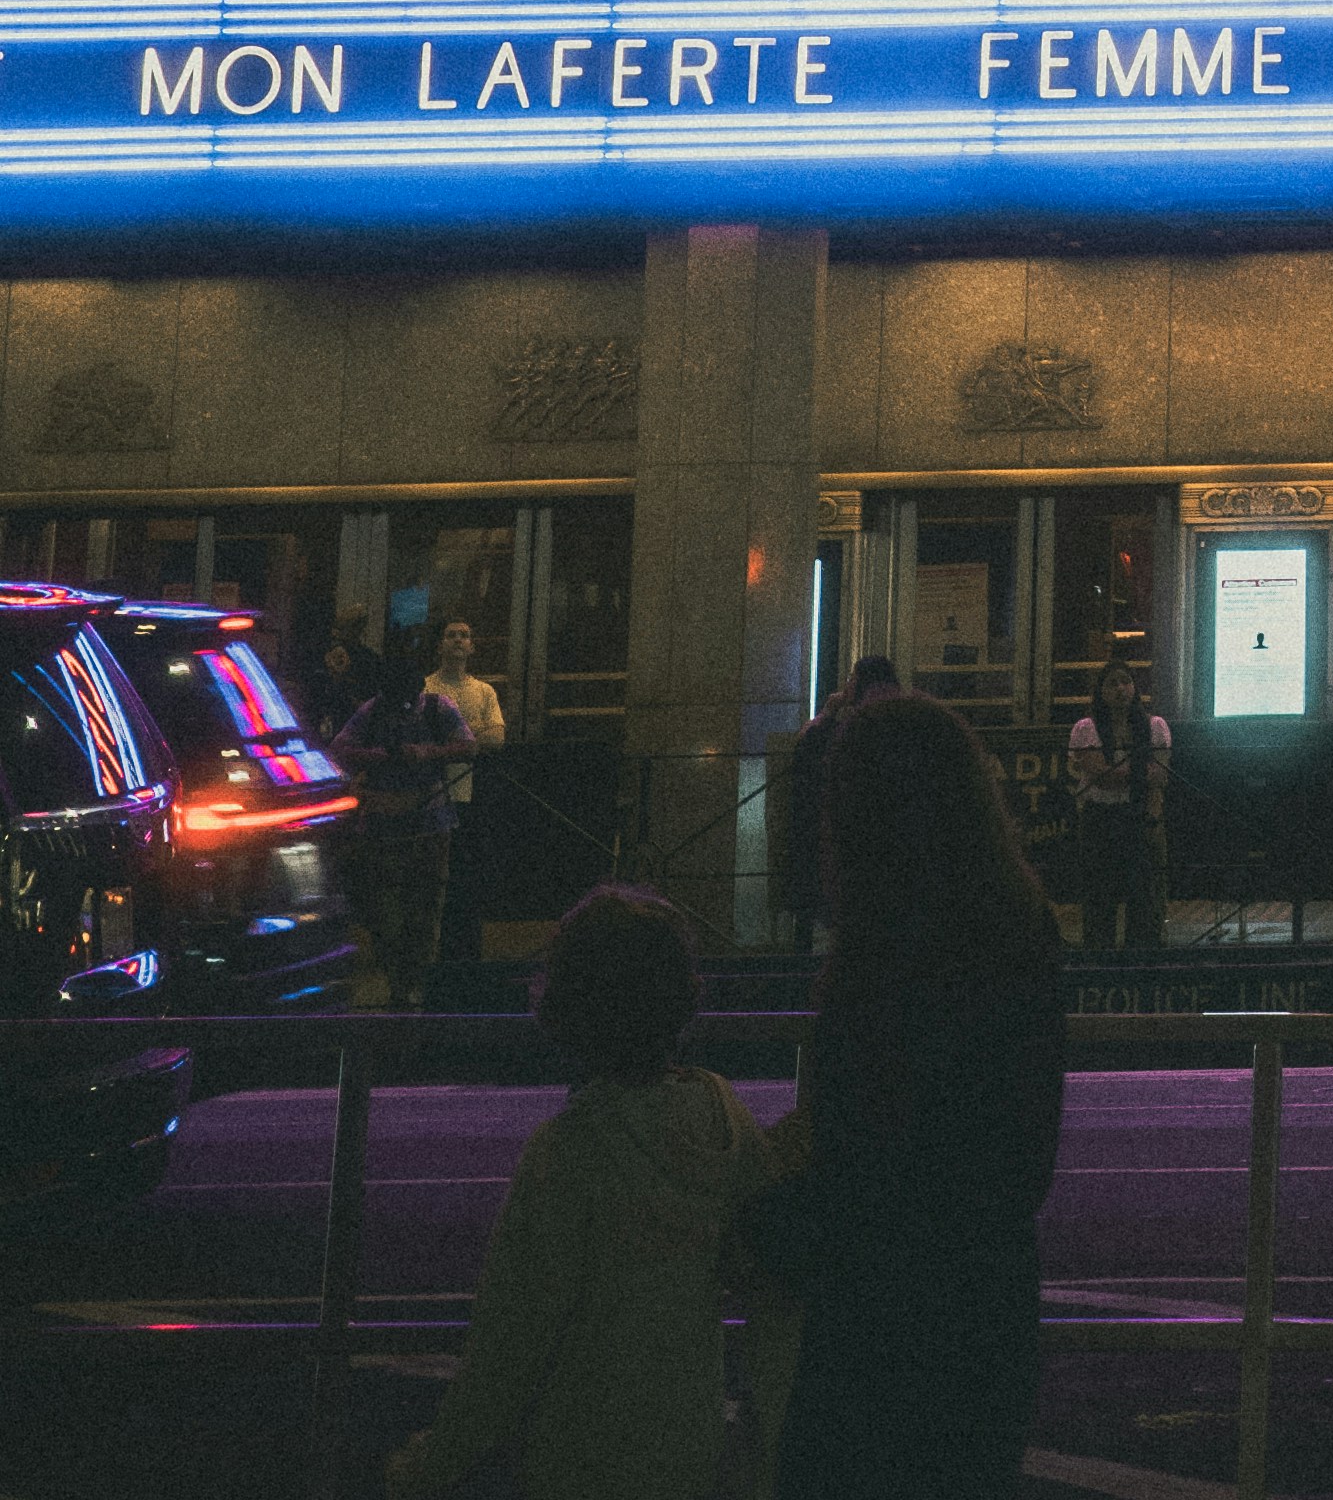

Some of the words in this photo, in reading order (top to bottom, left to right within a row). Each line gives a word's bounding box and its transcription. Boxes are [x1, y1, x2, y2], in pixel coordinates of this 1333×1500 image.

[140, 43, 343, 116] MON
[417, 36, 834, 111] LAFERTE
[978, 26, 1290, 99] FEMME
[1076, 984, 1213, 1014] POLICE
[1238, 981, 1319, 1012] LINE
